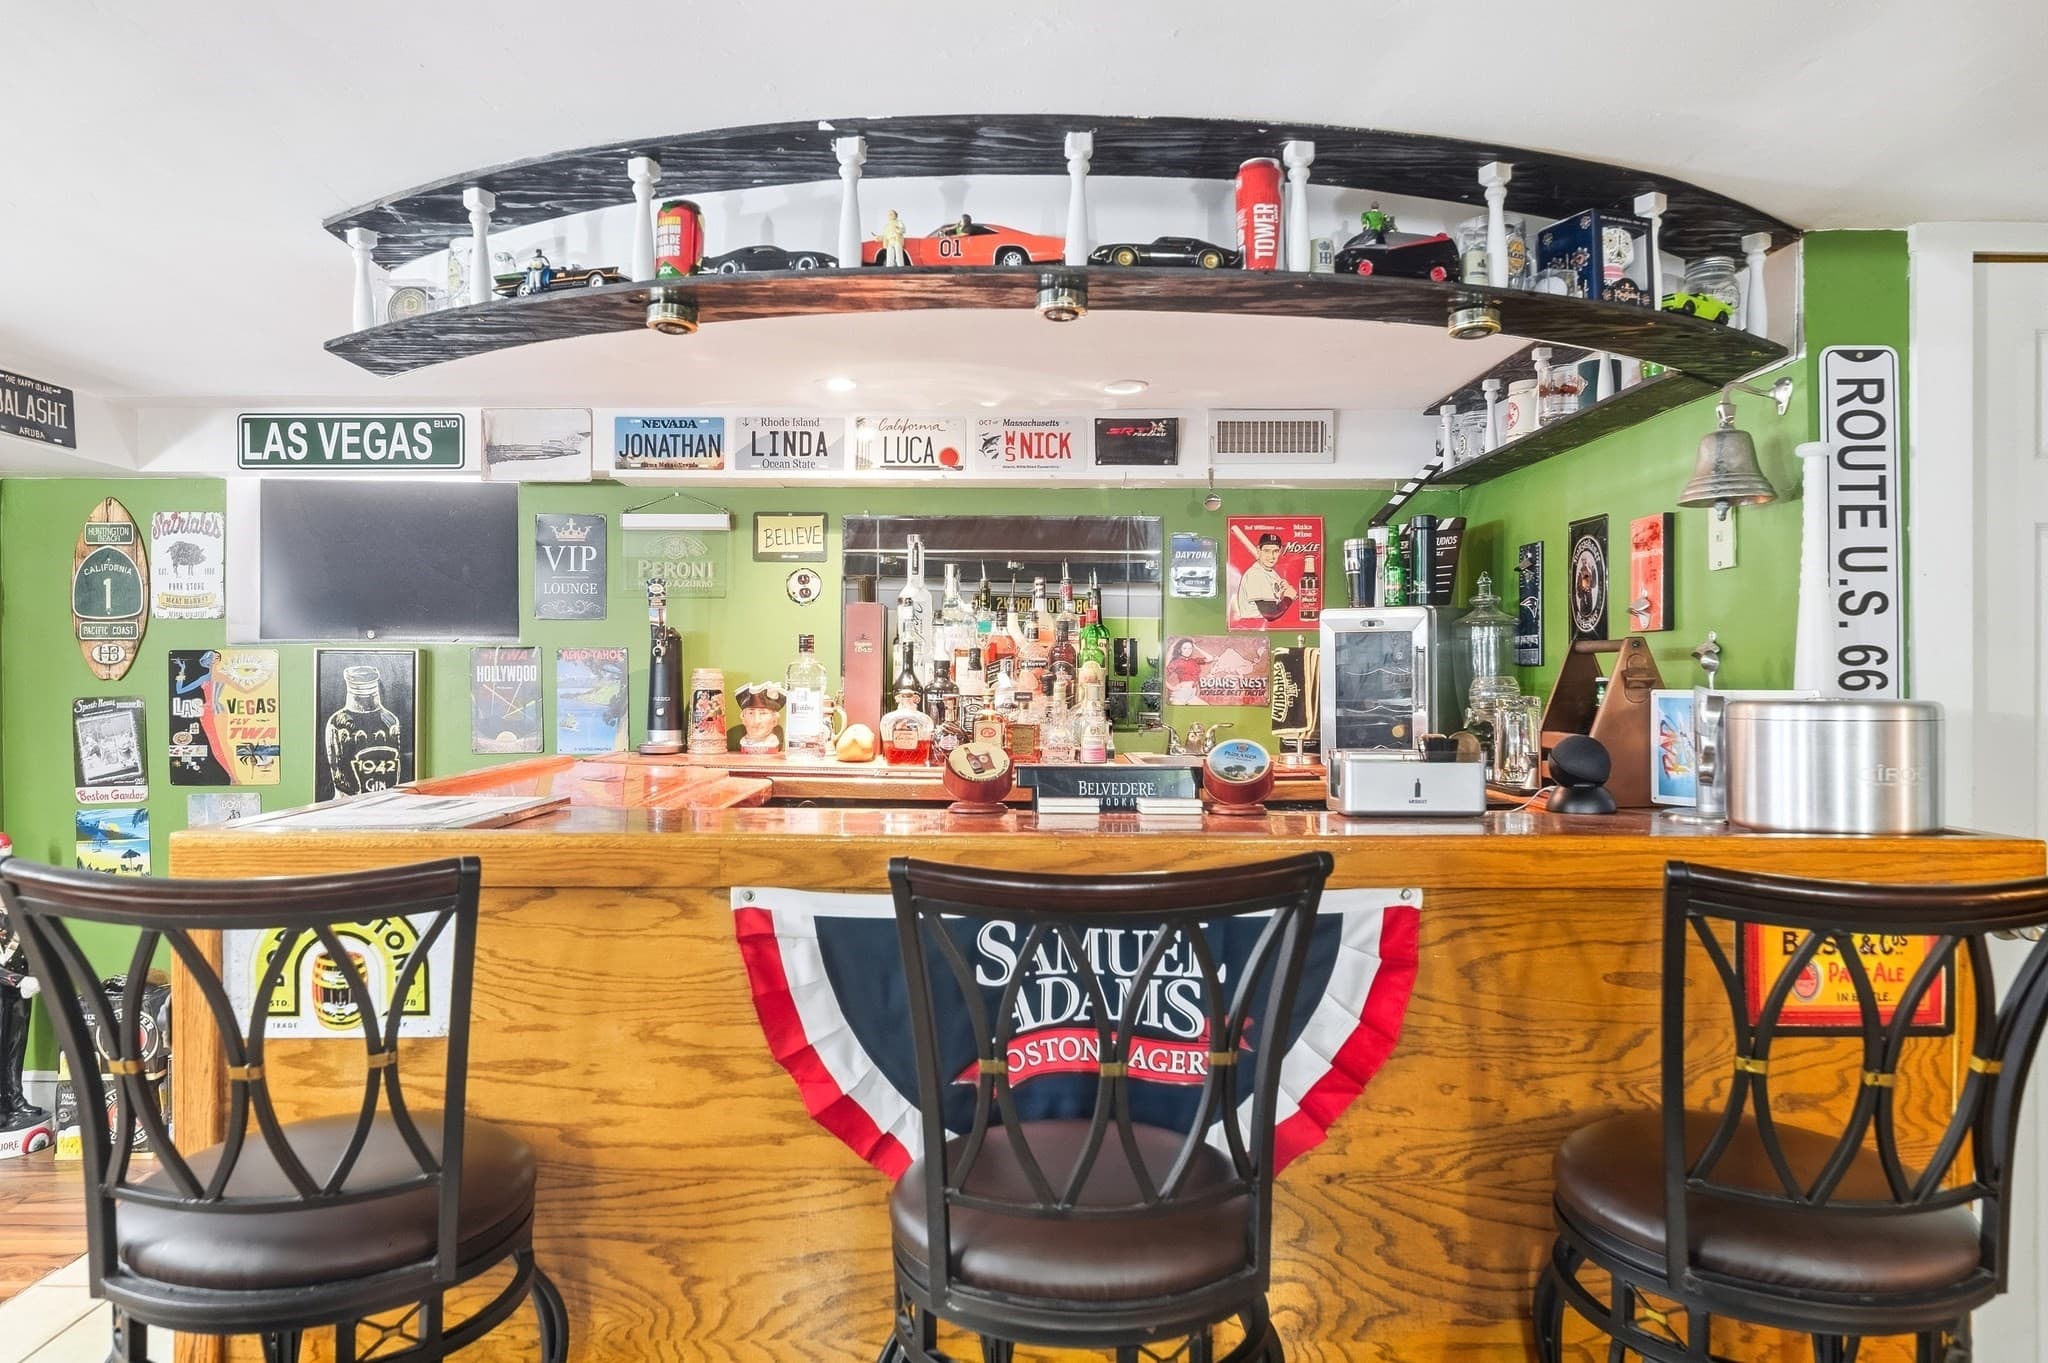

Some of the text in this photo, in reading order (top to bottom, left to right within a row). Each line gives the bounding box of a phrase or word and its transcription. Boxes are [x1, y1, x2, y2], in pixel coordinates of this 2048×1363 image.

[1254, 203, 1274, 259] TOWER
[940, 239, 962, 257] 01
[641, 419, 698, 429] NEVADA
[761, 417, 820, 428] Rhode Island
[878, 418, 946, 432] California
[1002, 418, 1060, 428] Massachusetts
[19, 426, 46, 440] ARUBA
[244, 419, 458, 461] LAS VEGAS BLVD
[619, 433, 722, 458] JONATHAN
[752, 430, 828, 457] LINDA
[883, 436, 935, 464] LUCA
[1019, 432, 1072, 460] NICK
[1836, 377, 1888, 530] ROUTE
[762, 458, 816, 469] Ocean State
[88, 527, 130, 536] HUNTINGTON
[763, 525, 823, 548] BELIEVE
[1175, 551, 1213, 559] DAYTONA
[1283, 541, 1320, 554] MOXIE
[543, 545, 597, 572] VIP
[83, 563, 133, 576] CALIFORNIA
[637, 559, 713, 579] PERONI
[103, 578, 112, 614] 1
[543, 582, 598, 595] LOUNGE
[1837, 546, 1889, 628] U.S.
[83, 625, 134, 635] PACIFIC COAST
[476, 665, 537, 683] HOLLYWOOD
[1837, 644, 1889, 692] 66
[1200, 677, 1267, 689] BOARS NEST
[173, 697, 276, 717] LAS VEGAS
[229, 727, 277, 739] TWA
[358, 759, 396, 774] 1942
[77, 790, 109, 802] Boston
[1078, 780, 1157, 797] BELVEDERE
[1783, 931, 1839, 955] BS
[1859, 934, 1877, 955] &
[976, 920, 1226, 986] SAMUEL
[1873, 962, 1905, 983] ALE
[1836, 992, 1849, 1002] IN
[1011, 977, 1204, 1038] ADAMS
[1006, 1037, 1208, 1075] OSTON AGER
